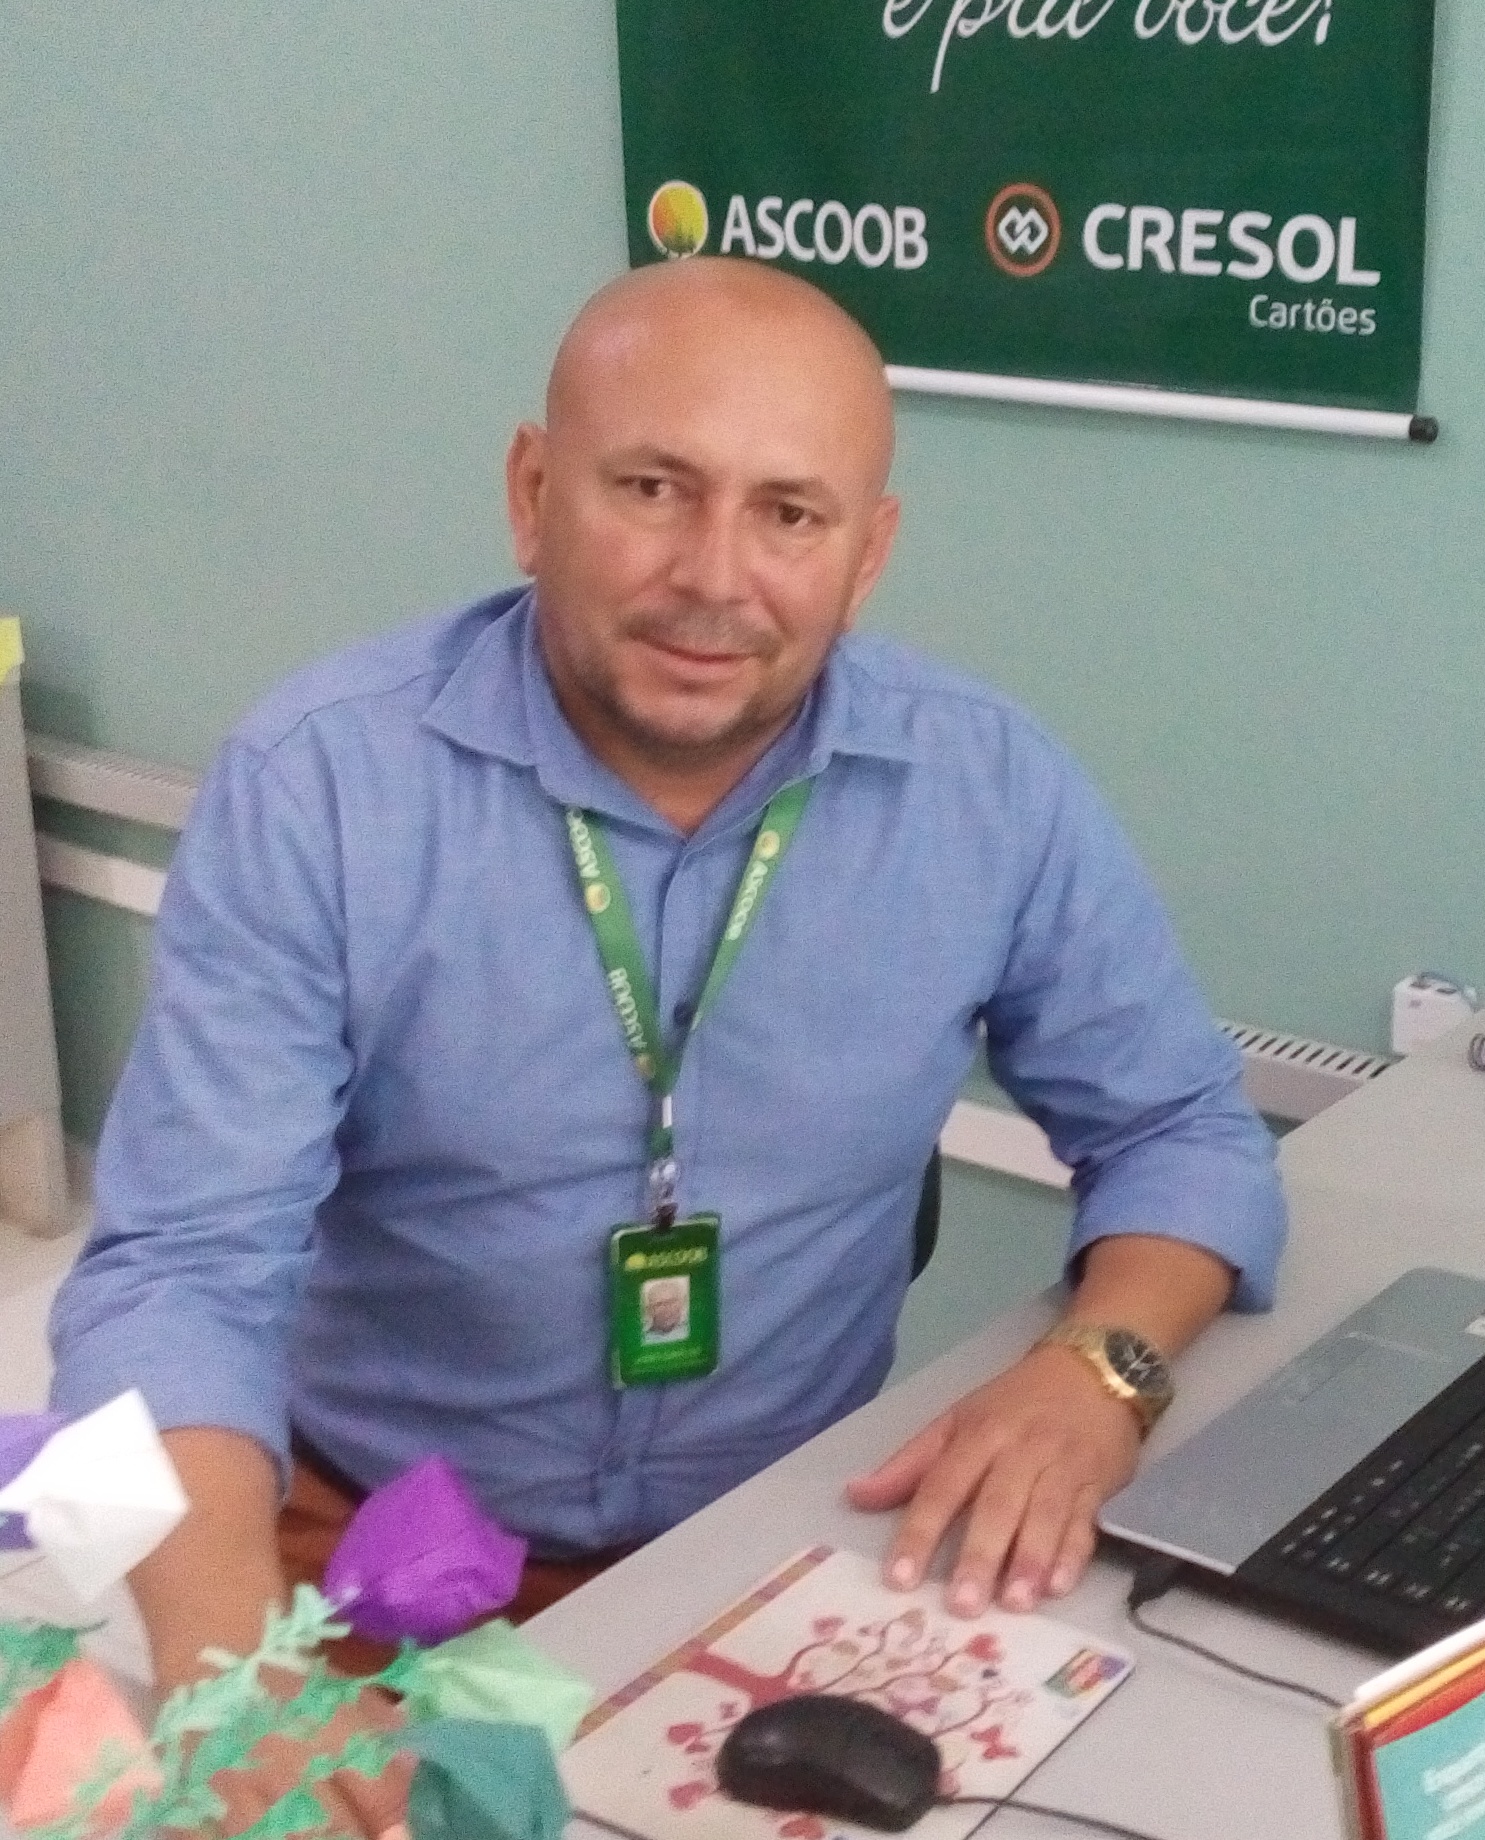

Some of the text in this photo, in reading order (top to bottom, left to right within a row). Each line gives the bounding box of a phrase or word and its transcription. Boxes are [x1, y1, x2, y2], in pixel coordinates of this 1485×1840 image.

[720, 194, 930, 270] ASCOOB
[1082, 203, 1382, 287] CRESOL
[1249, 294, 1377, 336] Cartões
[565, 806, 601, 878] ASCOO
